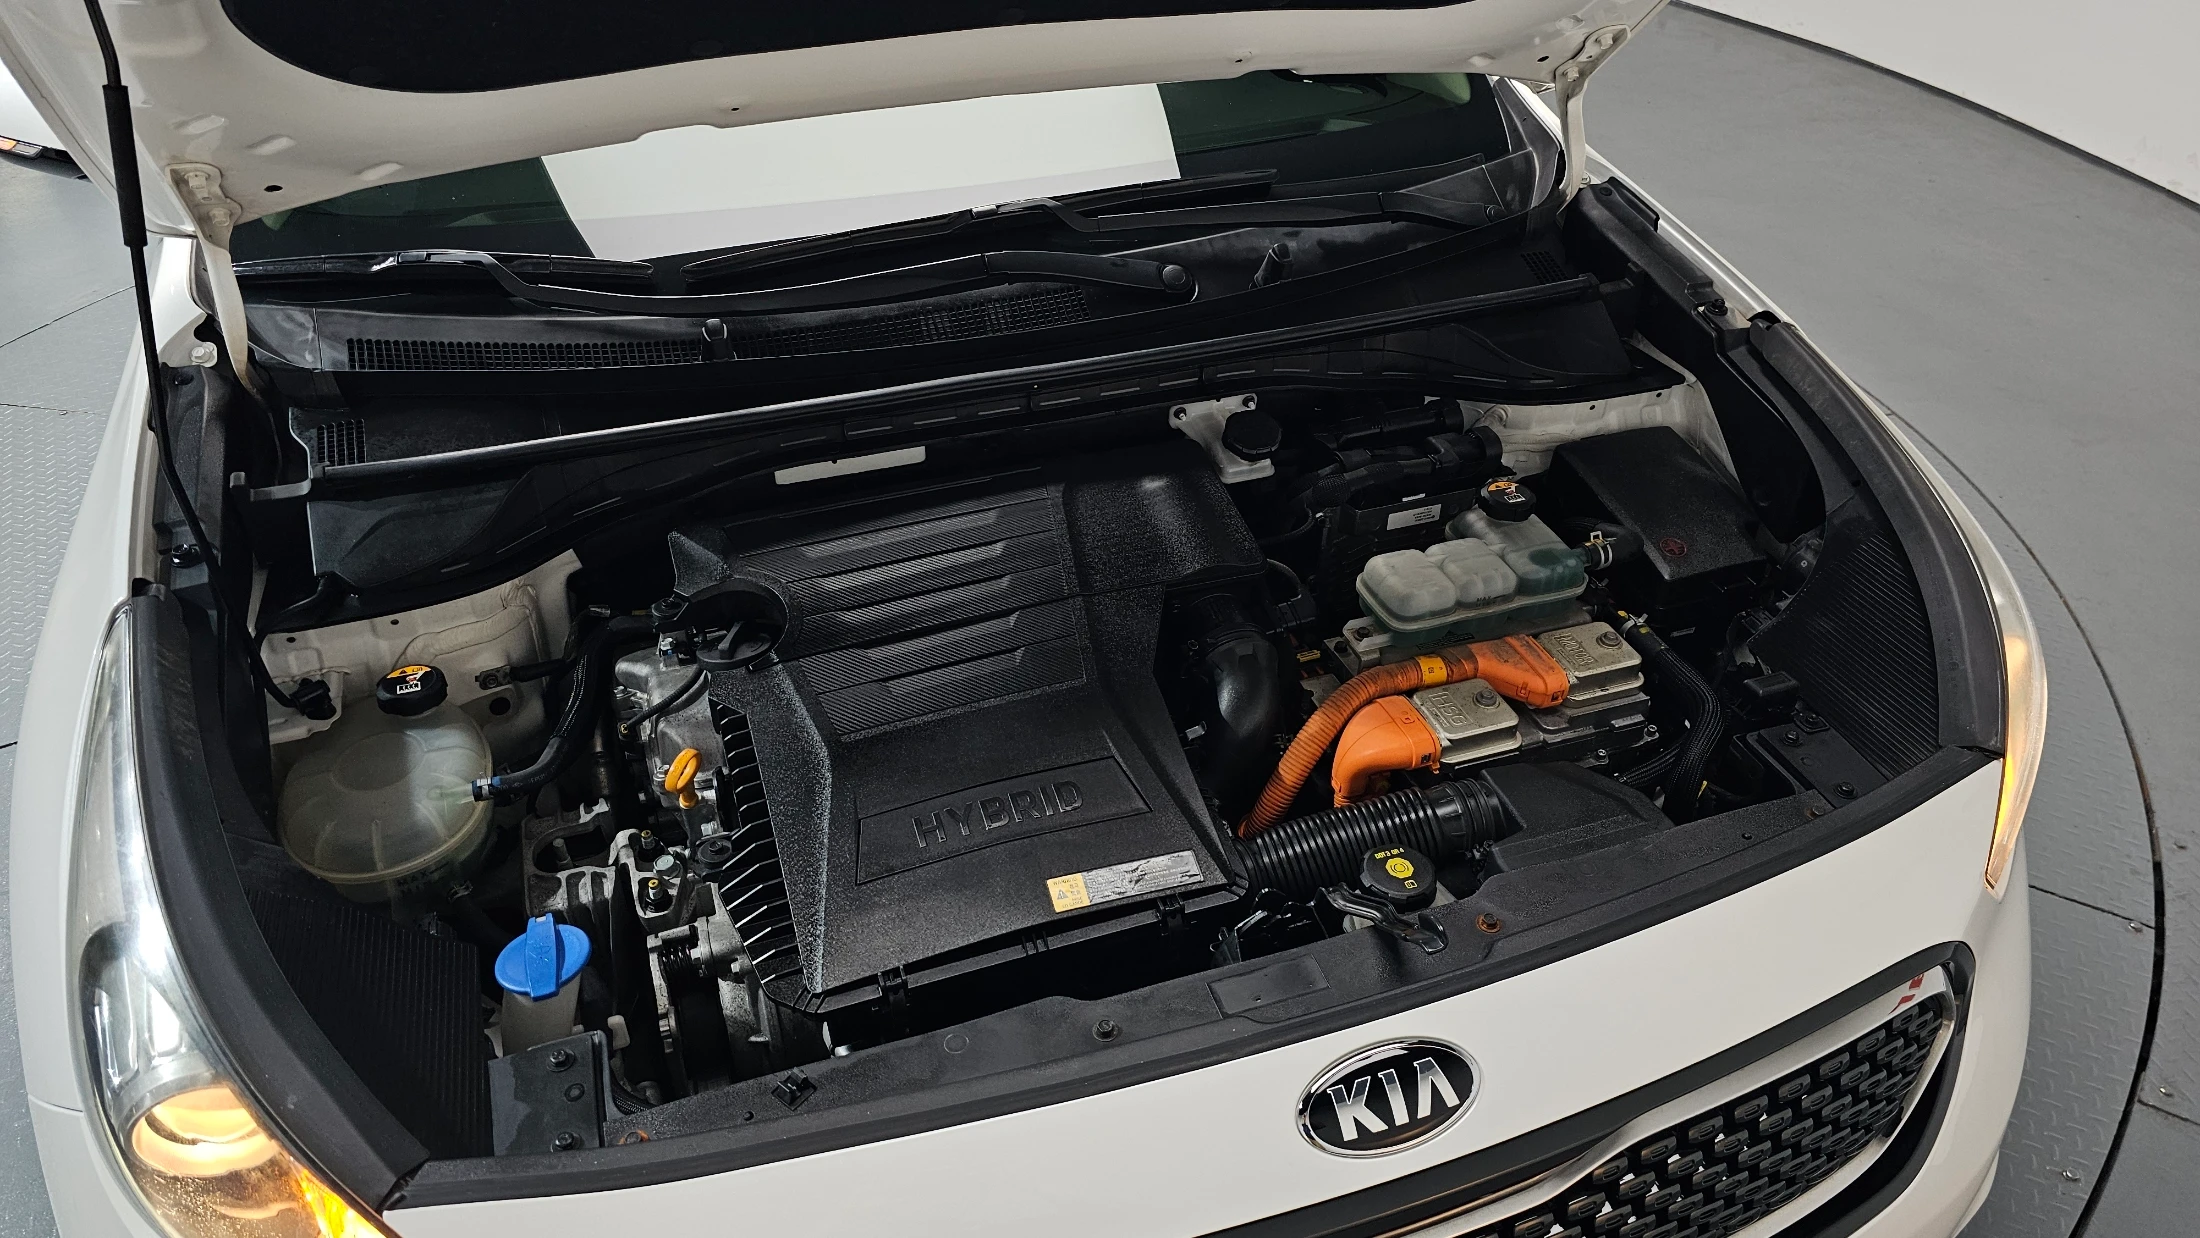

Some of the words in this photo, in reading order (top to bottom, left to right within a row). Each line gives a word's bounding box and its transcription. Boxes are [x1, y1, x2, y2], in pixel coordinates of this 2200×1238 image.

[1431, 695, 1468, 727] HSG
[912, 780, 1084, 848] HYBRID
[1374, 851, 1387, 860] DOT
[1326, 1056, 1461, 1142] KIA
